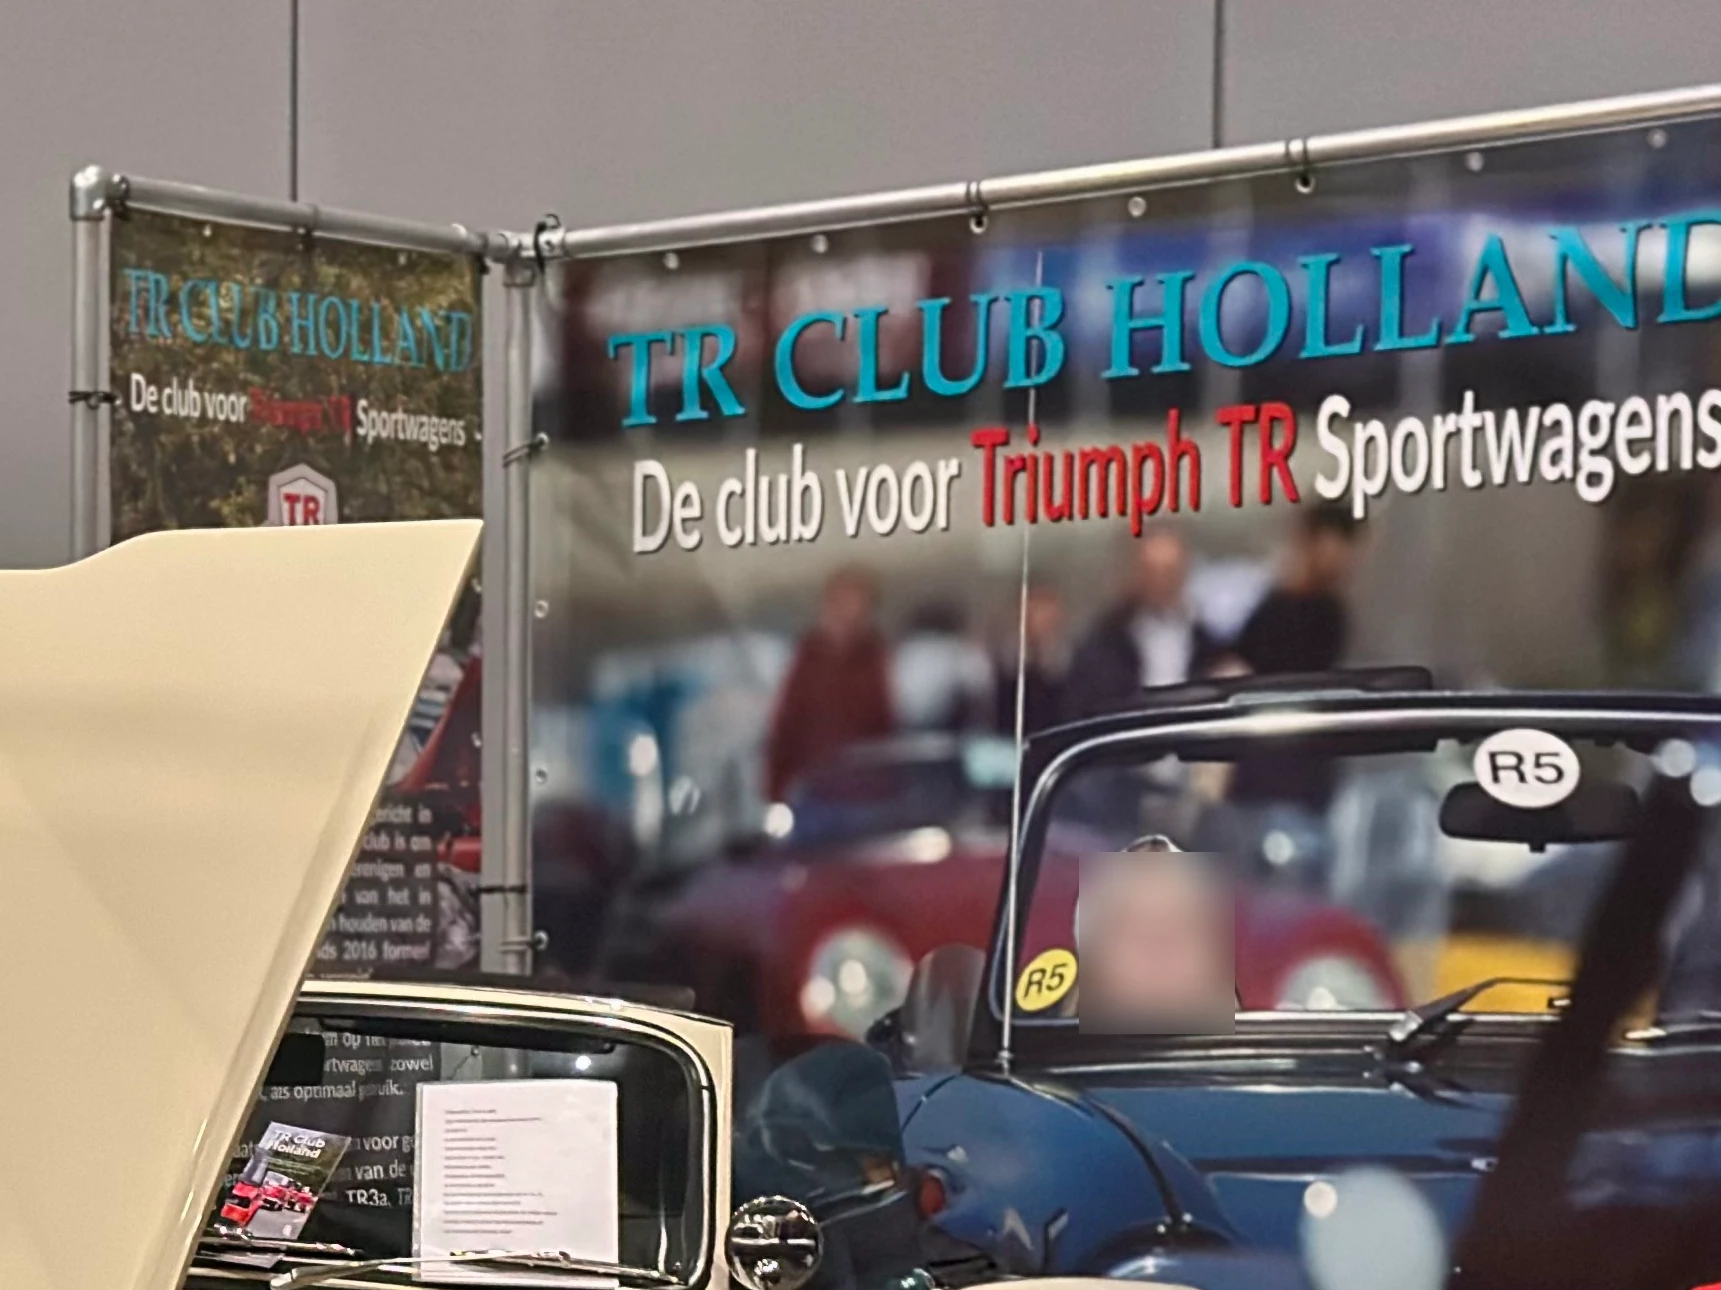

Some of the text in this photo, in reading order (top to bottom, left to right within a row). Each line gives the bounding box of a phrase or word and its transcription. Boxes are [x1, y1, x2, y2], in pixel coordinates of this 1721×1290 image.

[123, 268, 473, 372] TR CLUB HOLLAND
[608, 207, 1721, 428] TR CLUB HOLLAND
[130, 373, 159, 413] De
[162, 377, 201, 419] club
[203, 392, 248, 423] voor
[355, 398, 466, 451] Sportwagens
[633, 388, 1721, 553] De club voor Triumph TR Sportwagens
[283, 493, 320, 526] TR
[1488, 751, 1564, 785] R5
[342, 940, 377, 960] 2016
[1024, 963, 1068, 999] R5
[389, 1054, 433, 1072] zowel
[362, 1135, 399, 1151] voor
[354, 1164, 384, 1180] van
